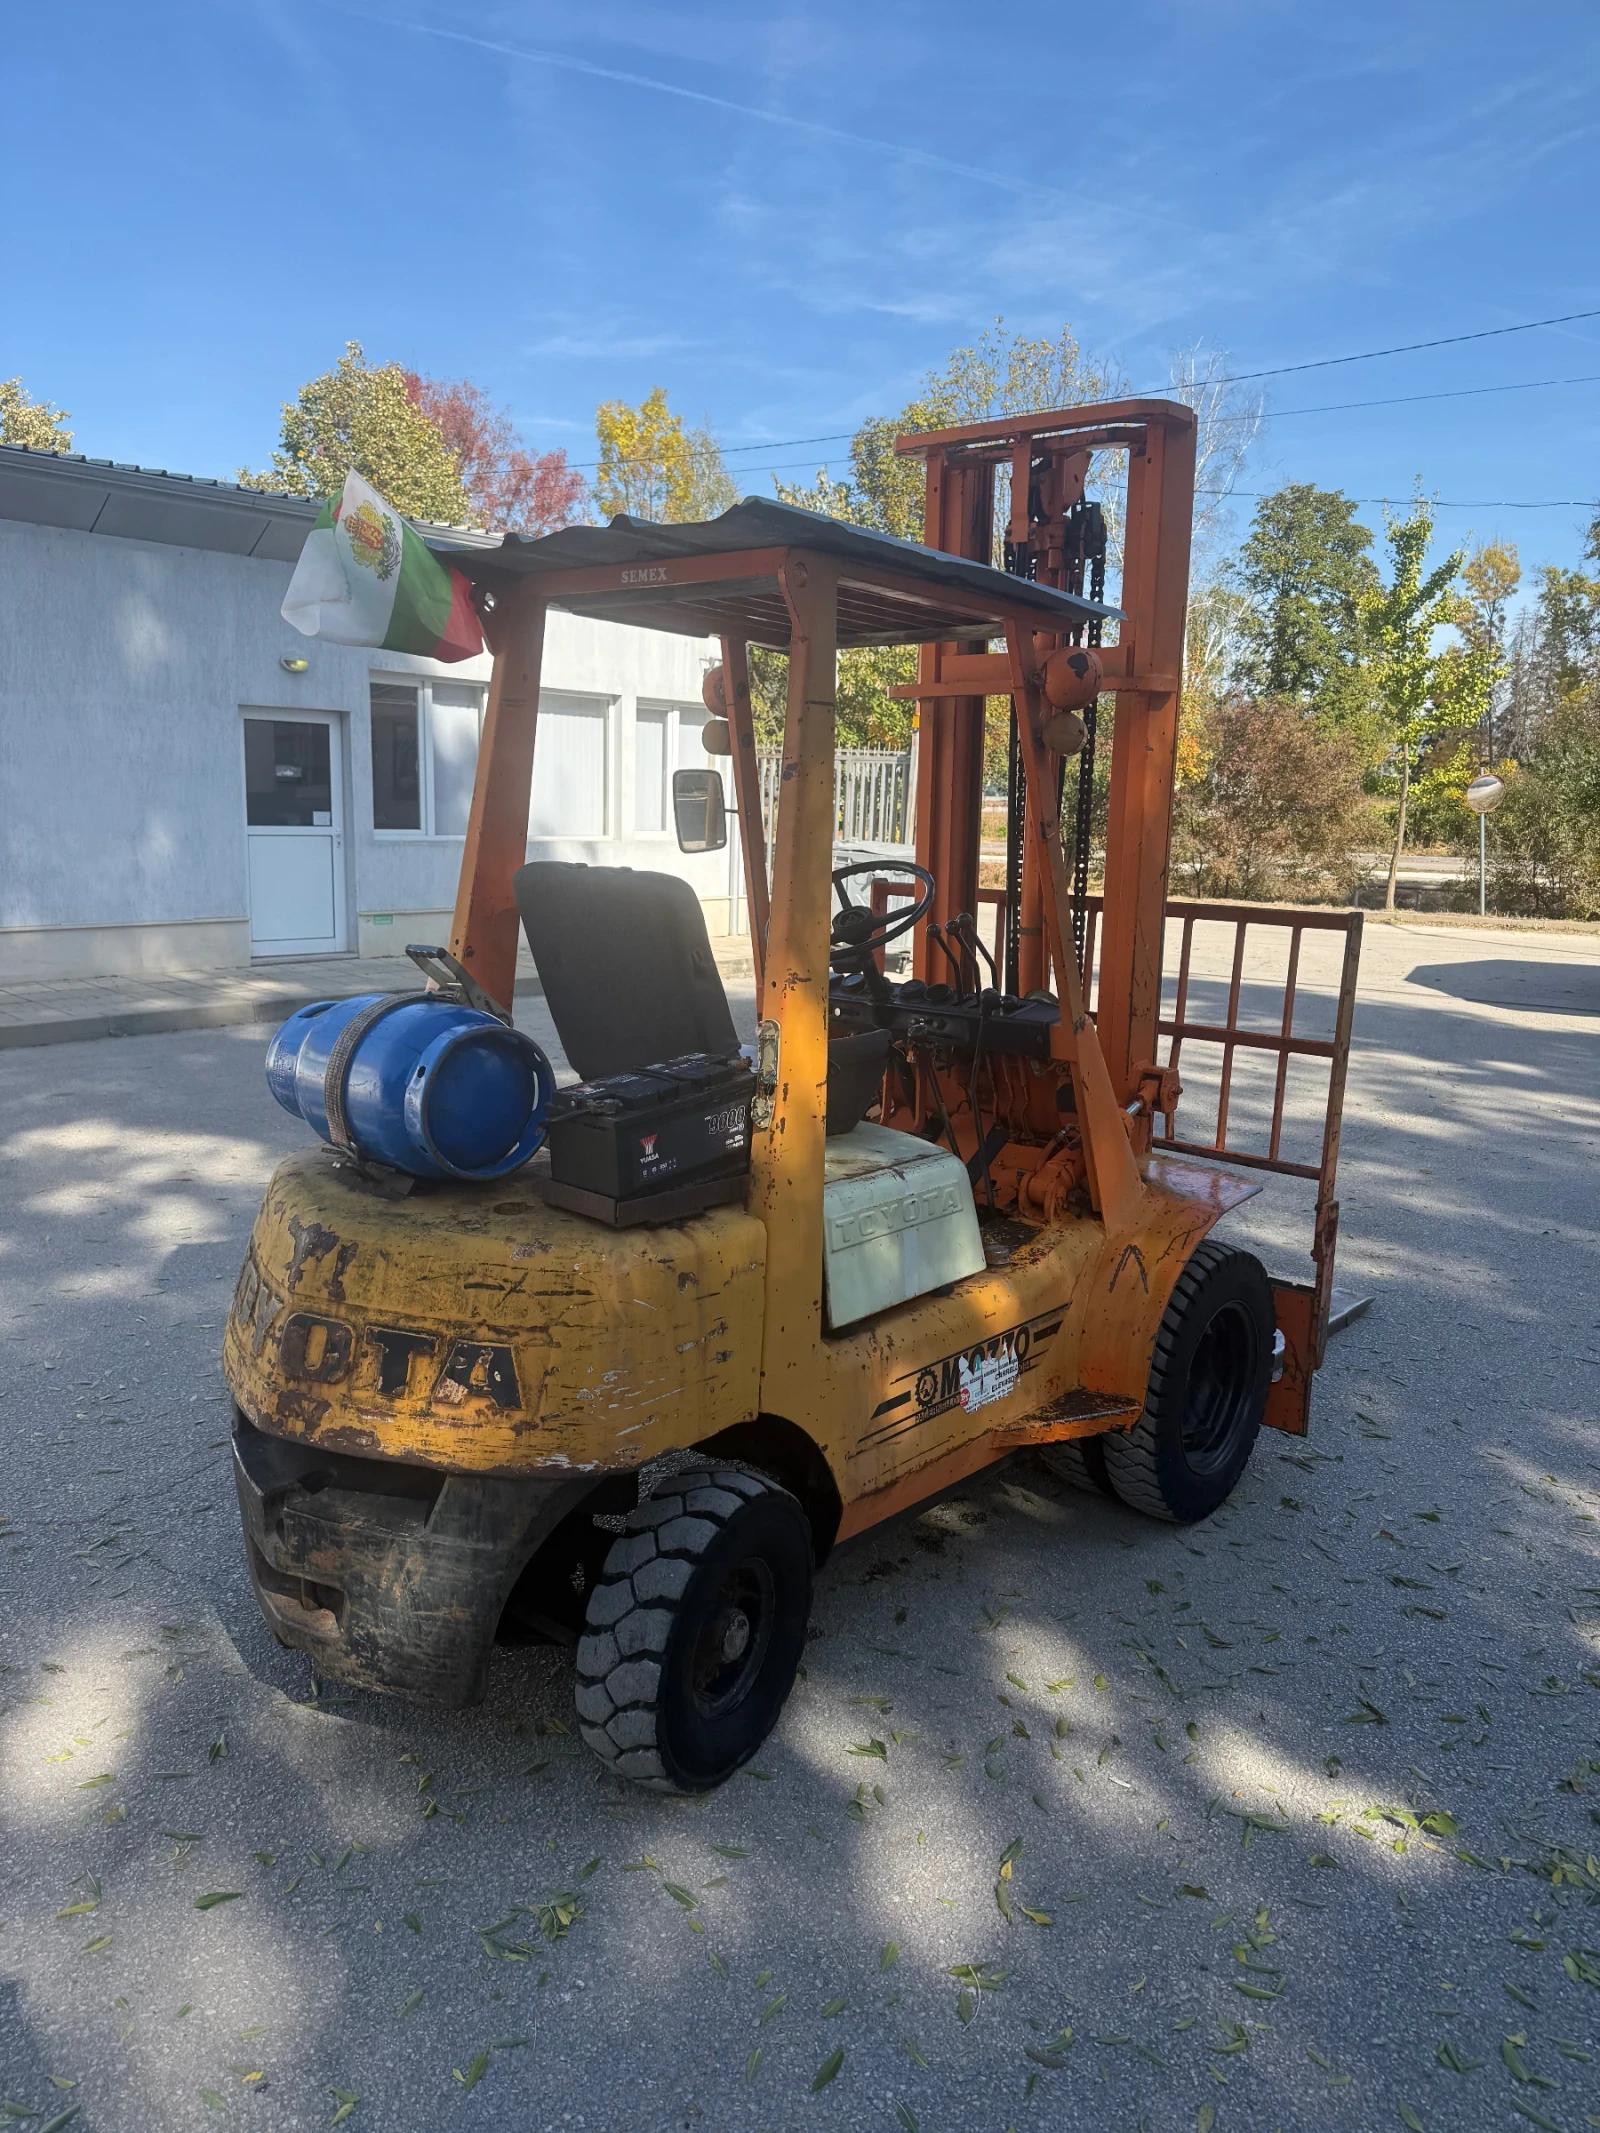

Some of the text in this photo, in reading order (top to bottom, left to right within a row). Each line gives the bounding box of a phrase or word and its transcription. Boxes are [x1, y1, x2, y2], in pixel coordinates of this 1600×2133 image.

[621, 567, 667, 583] SEMEX
[708, 1105, 746, 1134] 9000
[640, 1153, 660, 1164] YUASA
[835, 1187, 959, 1243] TOYOTA
